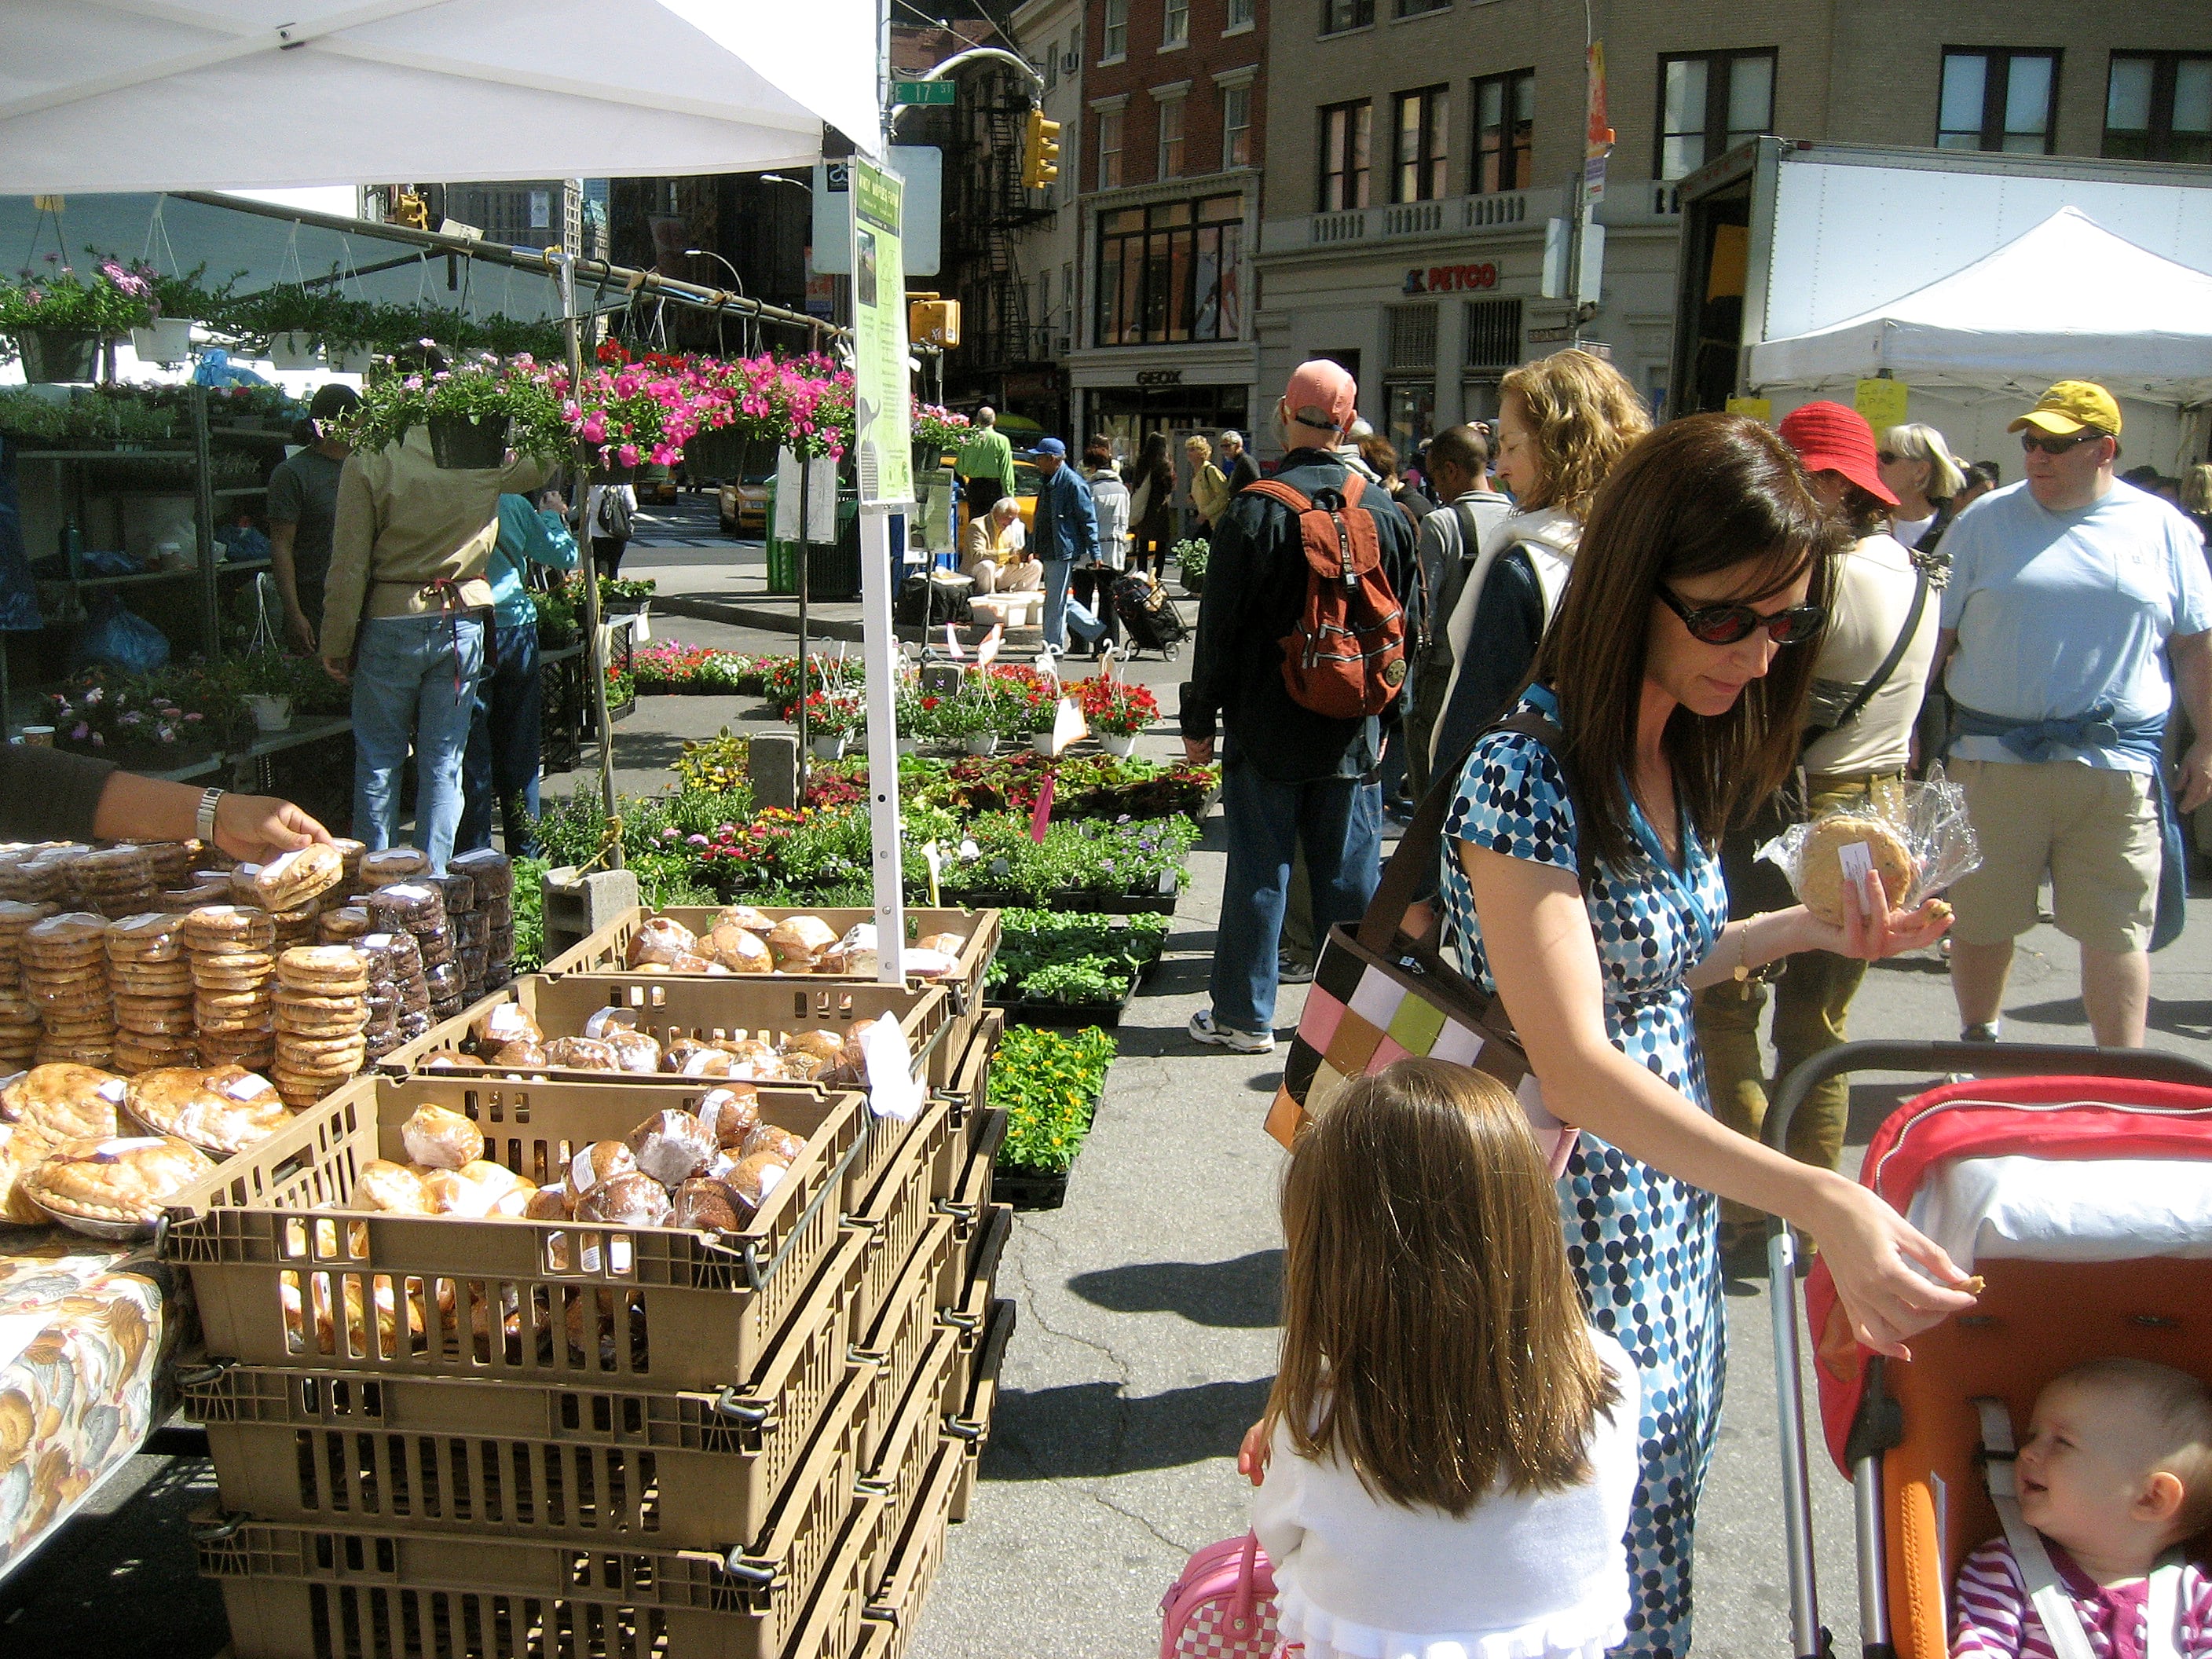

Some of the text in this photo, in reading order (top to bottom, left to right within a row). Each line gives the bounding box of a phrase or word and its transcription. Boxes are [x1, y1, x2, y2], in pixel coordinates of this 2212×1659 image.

[895, 85, 903, 101] E
[916, 84, 931, 101] 17
[1428, 263, 1496, 291] PETCO
[1136, 371, 1181, 385] GEOX
